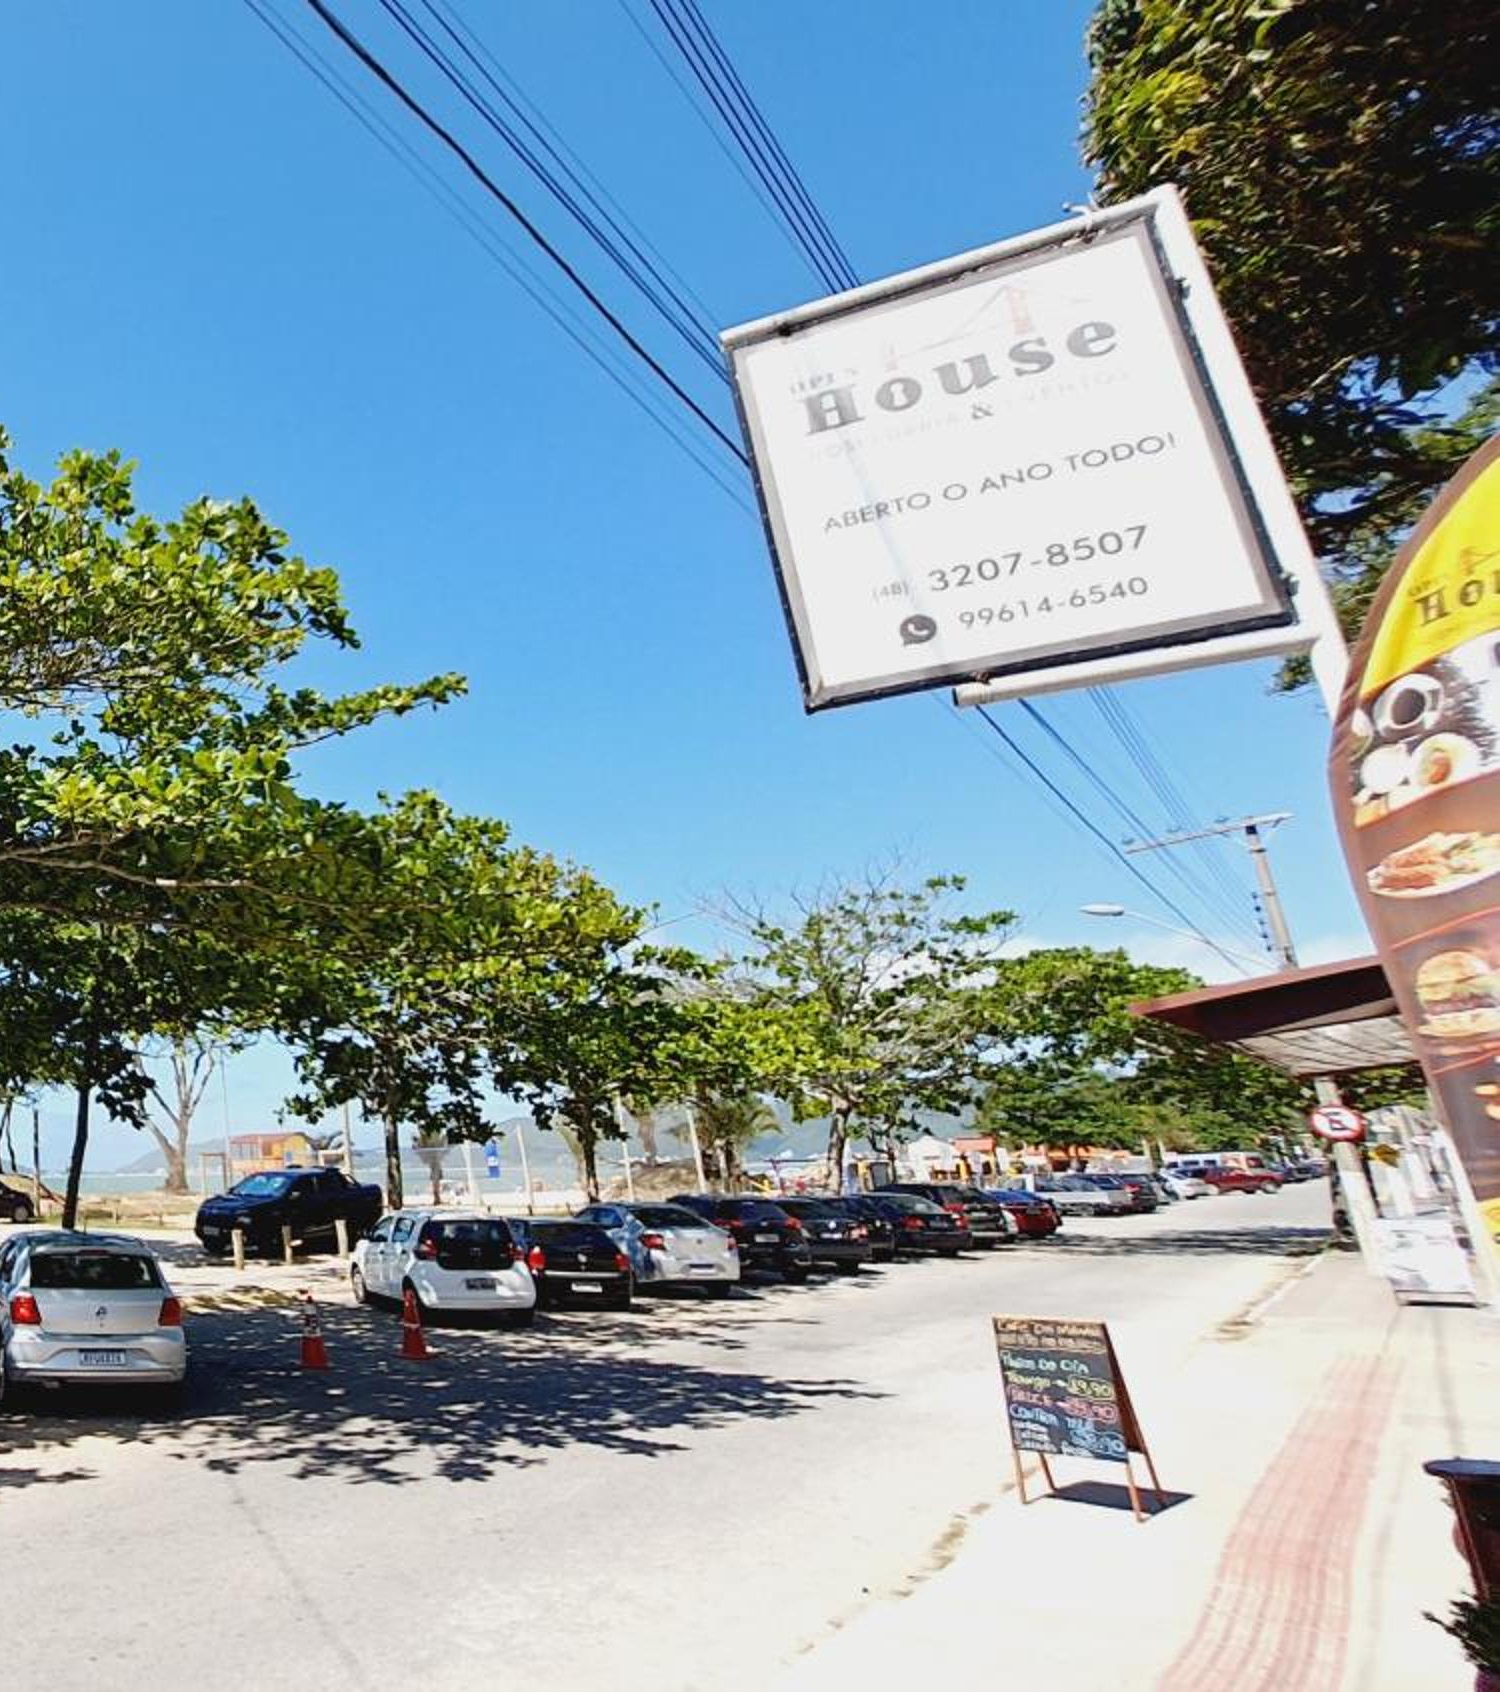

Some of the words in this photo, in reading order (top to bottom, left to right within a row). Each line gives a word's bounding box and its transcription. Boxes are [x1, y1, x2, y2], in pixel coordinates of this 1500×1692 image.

[806, 321, 1117, 436] House
[824, 493, 931, 533] ABERTO
[943, 484, 967, 500] O
[980, 463, 1052, 494] ANO
[1065, 432, 1177, 473] TODO!
[929, 525, 1148, 592] 3207-8507
[959, 576, 1148, 629] 99614-6540
